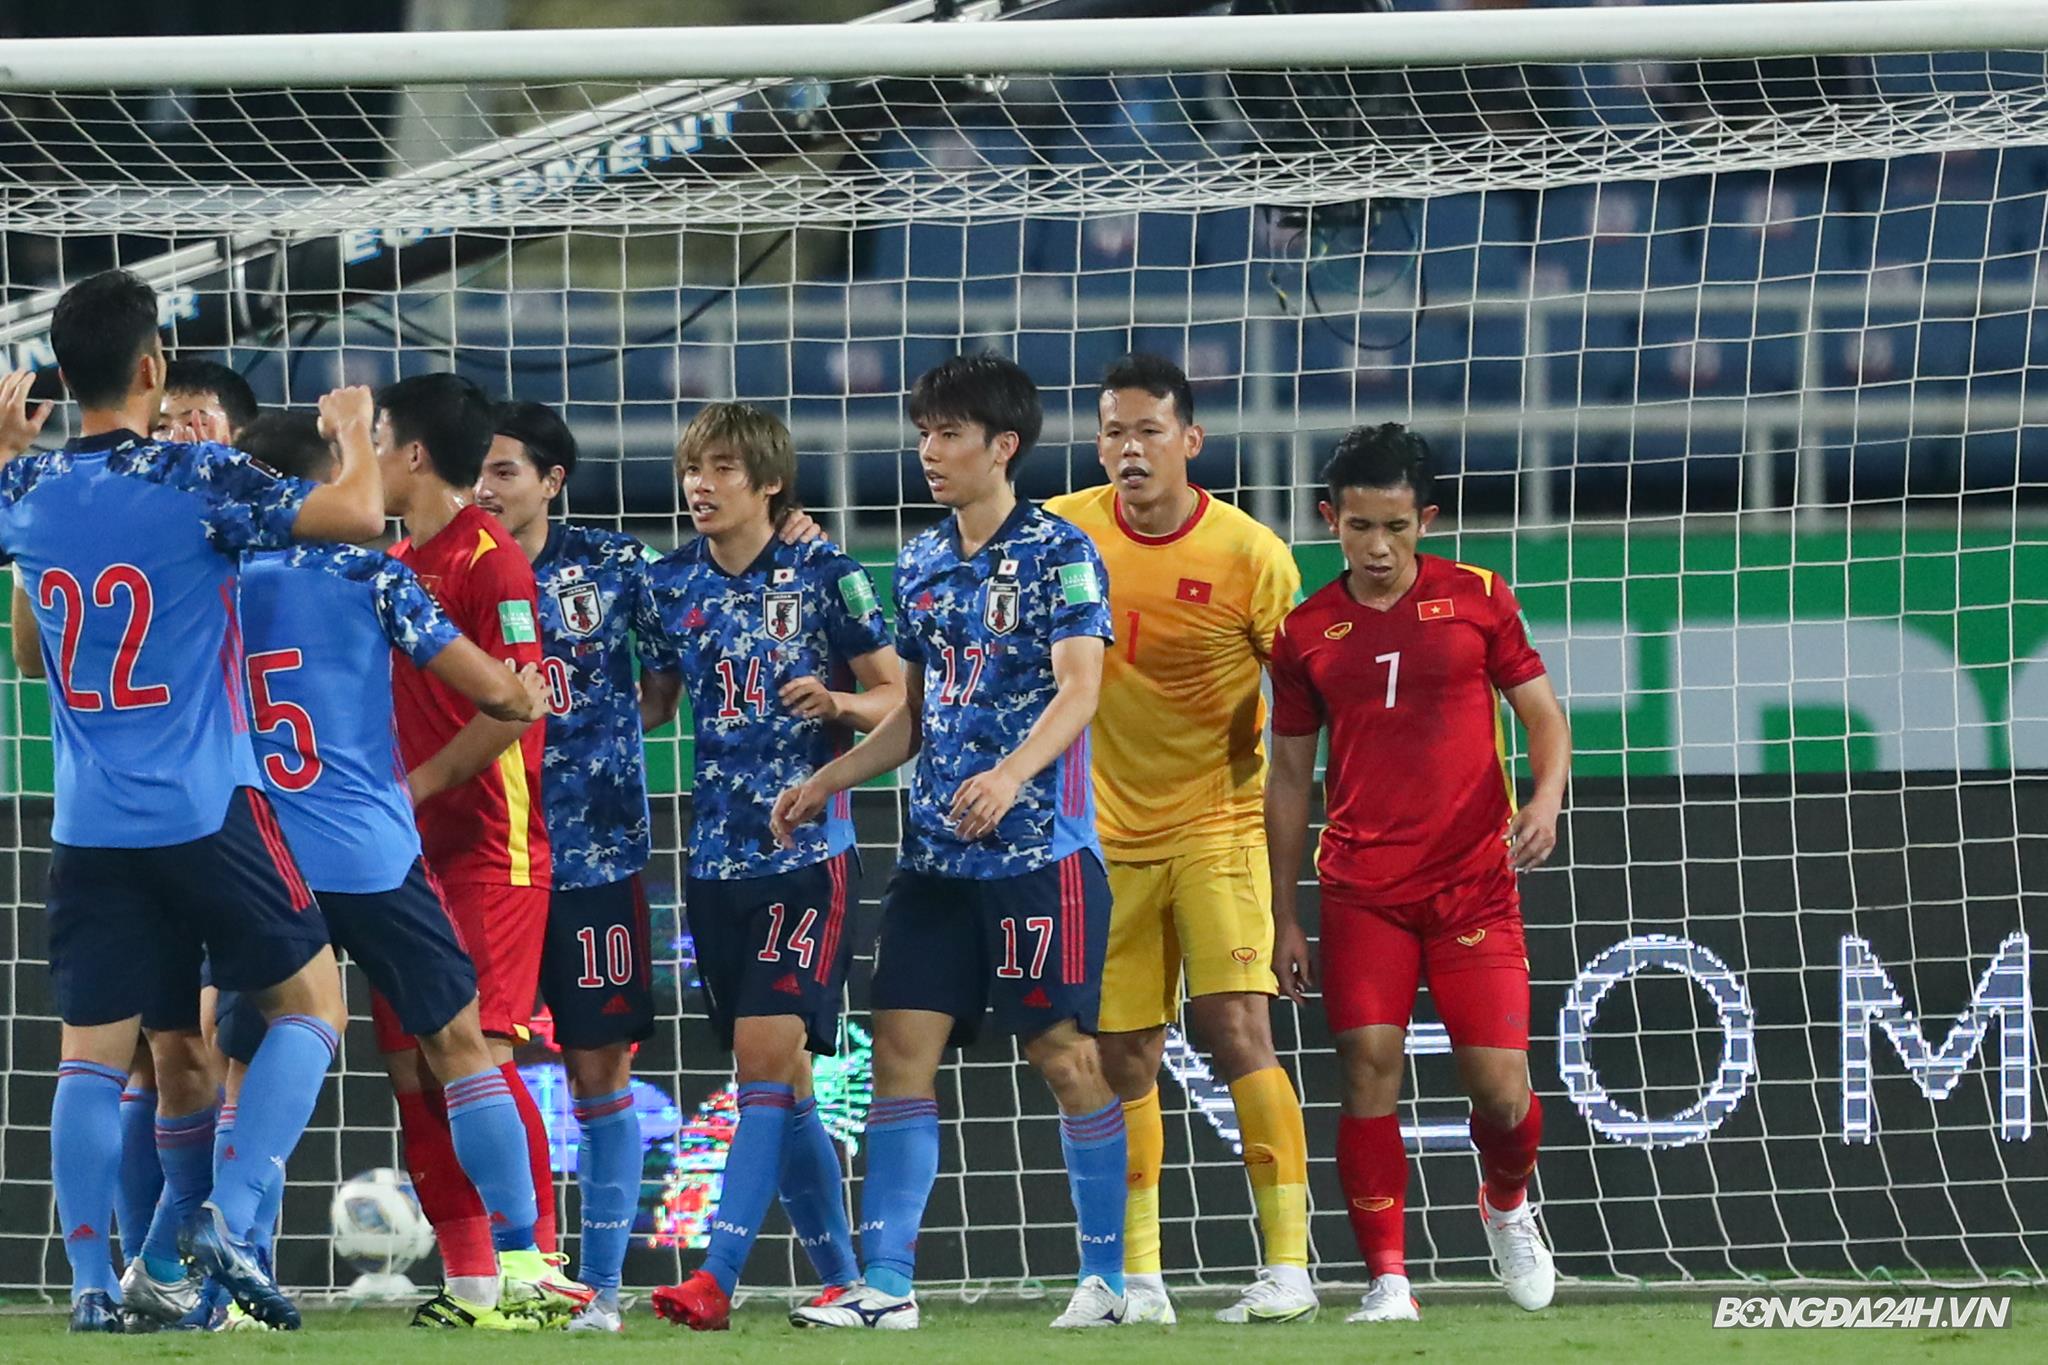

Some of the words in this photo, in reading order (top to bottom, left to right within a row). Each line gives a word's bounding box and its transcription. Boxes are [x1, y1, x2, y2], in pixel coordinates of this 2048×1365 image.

[38, 563, 170, 712] 22
[1126, 610, 1141, 664] 1
[541, 656, 573, 716] 0
[715, 656, 766, 720] 14
[938, 646, 984, 706] 17
[1374, 651, 1401, 709] 7
[246, 648, 323, 792] 5
[577, 923, 633, 988] 10
[757, 903, 818, 969] 14
[996, 916, 1054, 979] 17
